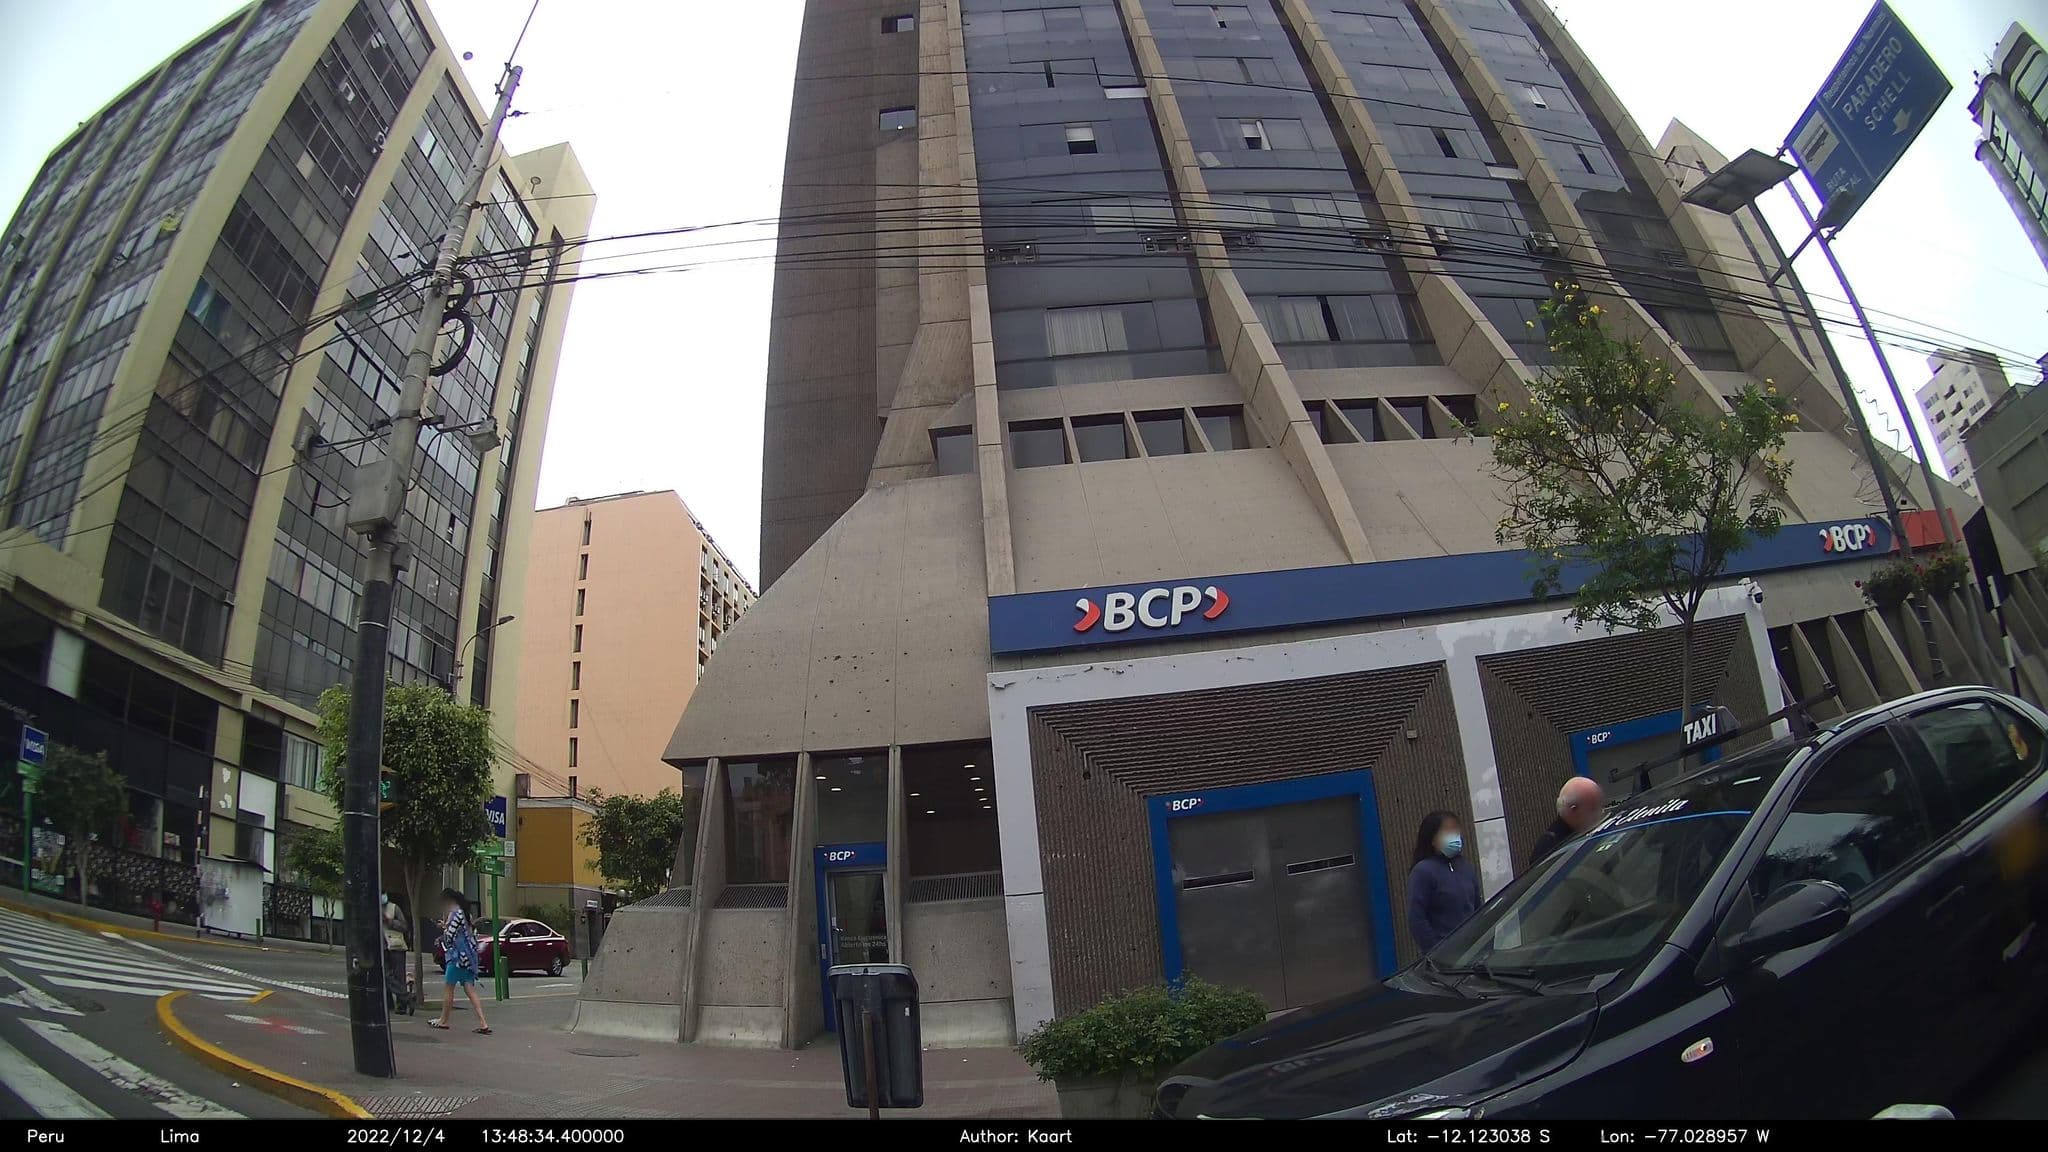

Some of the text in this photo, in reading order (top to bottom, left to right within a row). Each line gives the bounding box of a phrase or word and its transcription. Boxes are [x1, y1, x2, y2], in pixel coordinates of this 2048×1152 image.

[1842, 36, 1903, 121] PARADERO
[1864, 71, 1911, 131] SCHELL
[1829, 524, 1866, 552] BCP
[1103, 586, 1202, 632] BCP
[1591, 733, 1608, 744] BCP
[1683, 713, 1717, 745] TAXI
[485, 808, 505, 825] VISA
[1172, 798, 1197, 811] BCP
[829, 851, 851, 861] BCP
